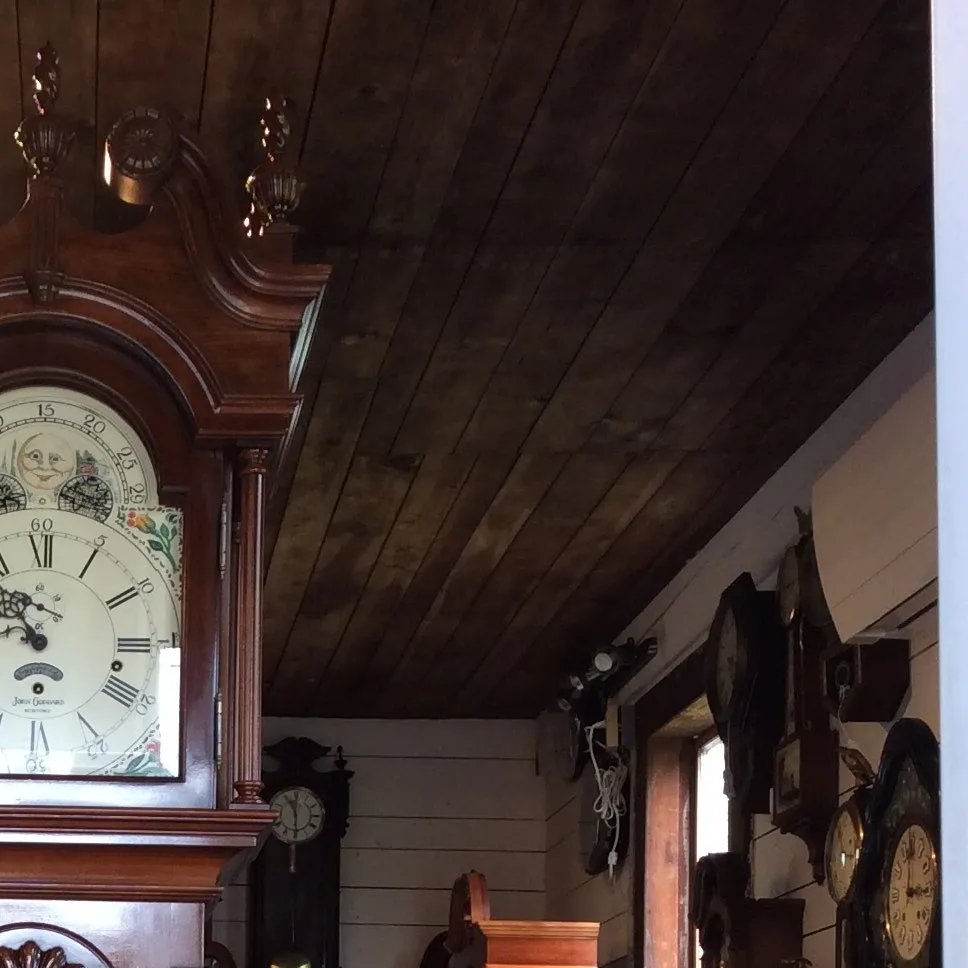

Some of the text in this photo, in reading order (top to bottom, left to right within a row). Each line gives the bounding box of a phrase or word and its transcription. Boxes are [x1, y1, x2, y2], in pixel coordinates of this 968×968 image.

[37, 403, 55, 417] 15
[85, 414, 107, 434] 20
[117, 446, 138, 470] 25
[130, 483, 145, 504] 29
[31, 518, 53, 532] 60
[94, 534, 108, 547] 5
[28, 533, 53, 569] XII
[137, 577, 154, 594] 10
[105, 586, 140, 610] II
[117, 637, 151, 653] III
[101, 674, 140, 708] IIII
[136, 693, 156, 716] 20
